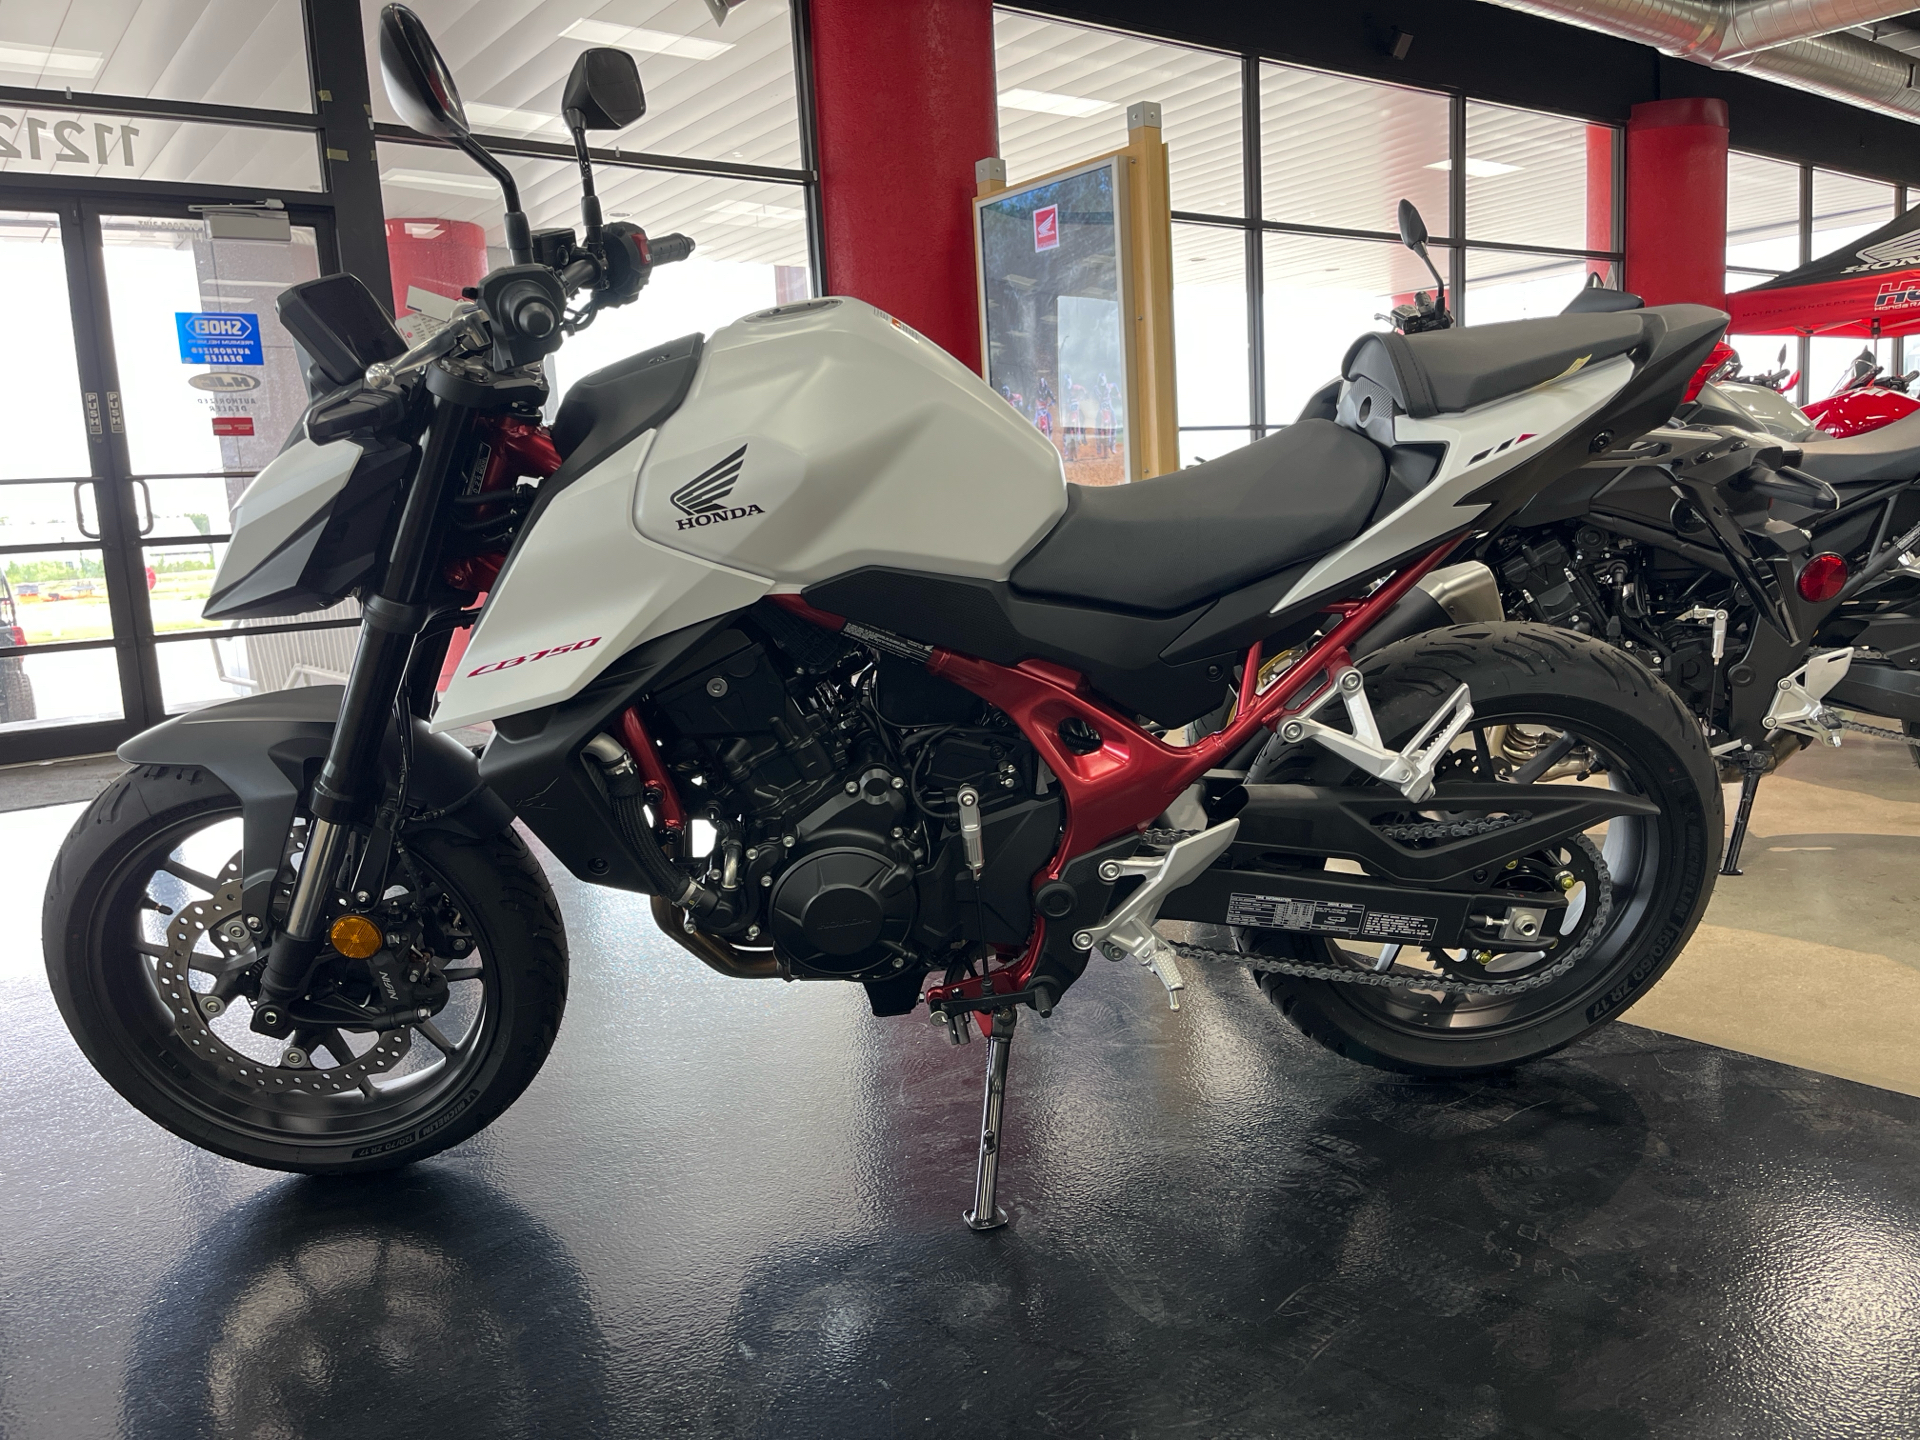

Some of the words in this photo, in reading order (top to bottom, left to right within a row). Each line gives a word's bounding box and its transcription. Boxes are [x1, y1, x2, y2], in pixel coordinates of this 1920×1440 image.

[1742, 308, 1783, 317] MATRIX
[1874, 302, 1909, 312] Honda
[88, 394, 99, 426] PUSH
[109, 393, 121, 425] PUSH
[675, 503, 765, 531] HONDA
[467, 636, 602, 678] CB750
[1674, 824, 1702, 920] MICHELIN
[1633, 928, 1675, 982] 160/60
[378, 970, 399, 1001] NISSIN
[1611, 983, 1634, 1003] ZR
[1592, 1001, 1611, 1018] 17
[422, 1099, 466, 1136] MICHELIN
[359, 1147, 369, 1157] 17
[370, 1145, 383, 1154] ZR
[385, 1134, 414, 1151] 120/70
